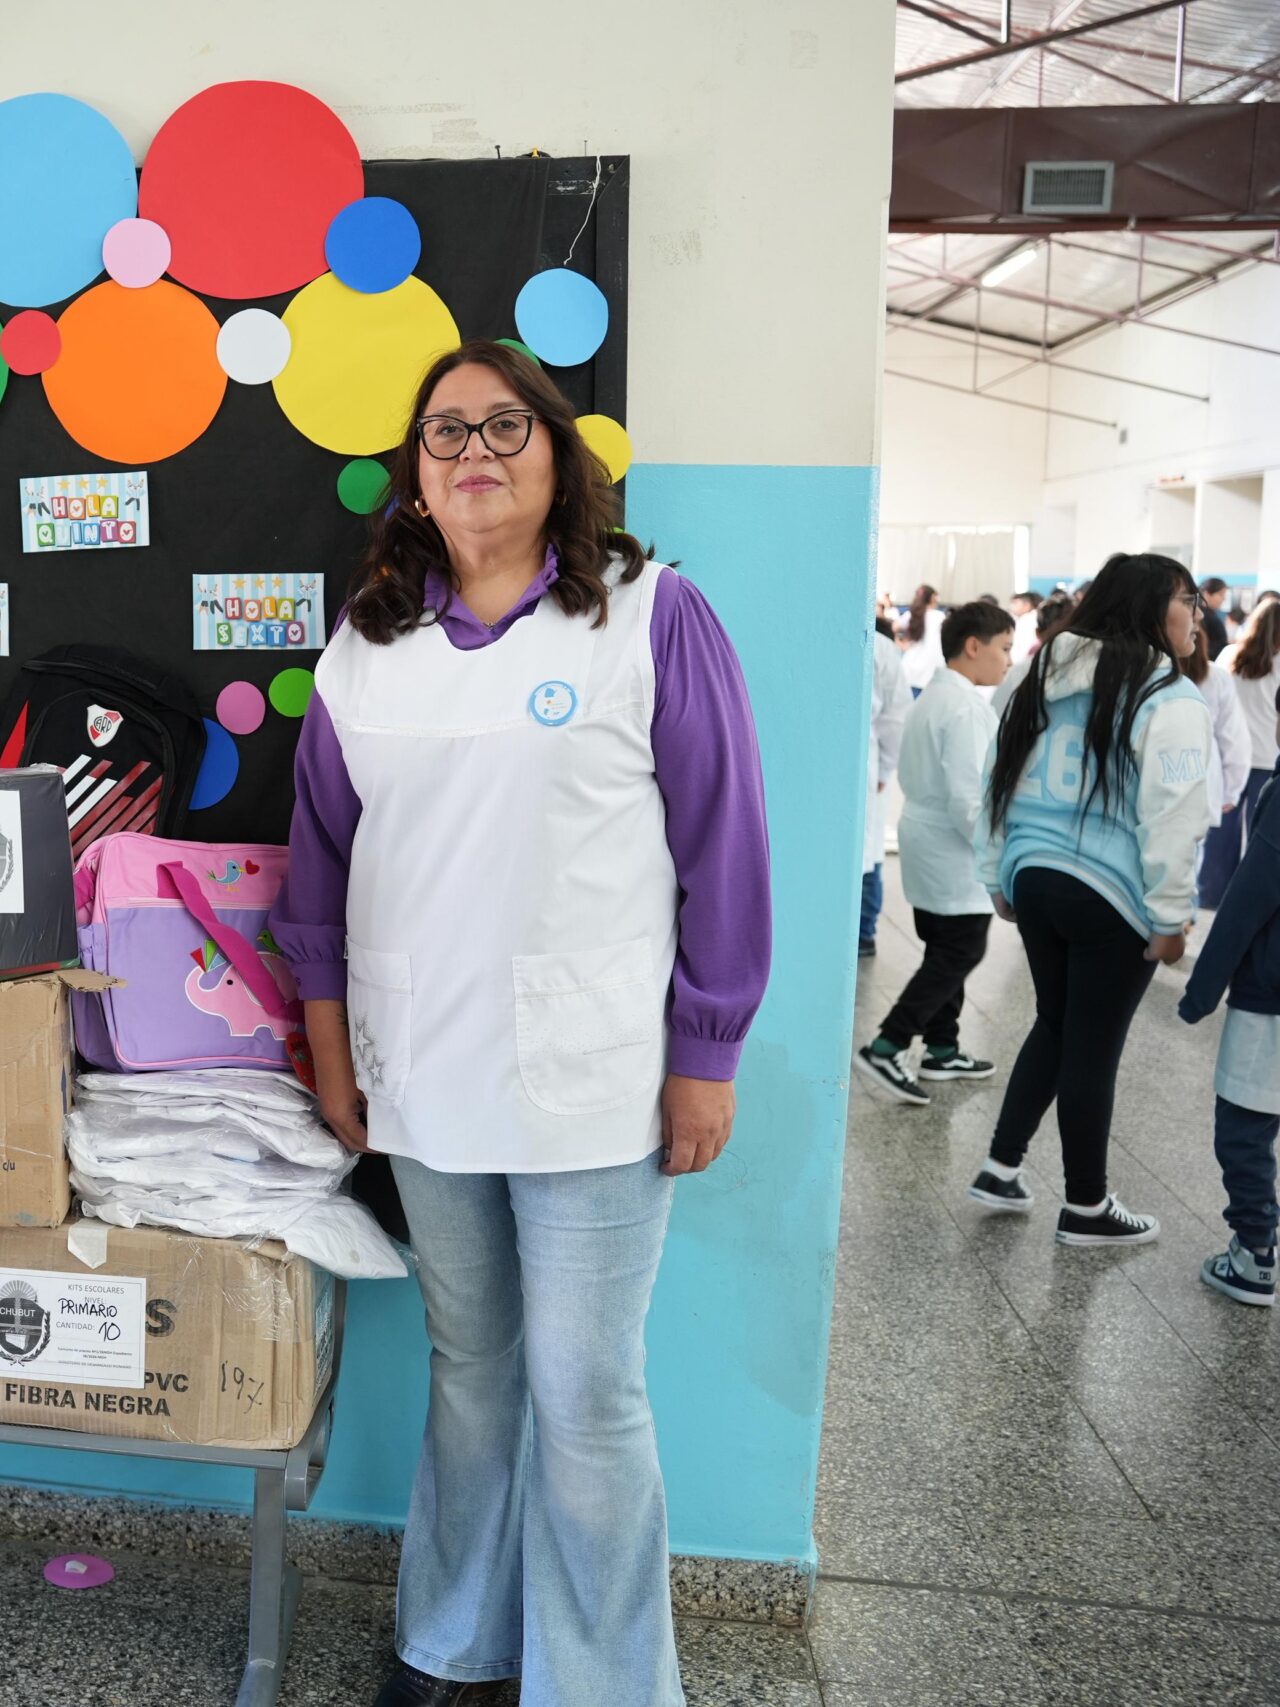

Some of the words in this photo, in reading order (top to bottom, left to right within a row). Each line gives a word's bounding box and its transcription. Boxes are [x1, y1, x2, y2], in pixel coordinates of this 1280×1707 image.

[52, 495, 117, 519] HOLA
[37, 521, 136, 546] QUINTO
[225, 598, 295, 620] HOLA
[217, 622, 304, 646] SEXTO
[84, 1285, 124, 1295] ESCOLARES
[0, 1307, 36, 1317] CHUBUT
[58, 1298, 118, 1318] PRIMARIO
[56, 1322, 95, 1331] CANTIDAD:
[98, 1321, 121, 1342] 10
[144, 1372, 189, 1393] PVC
[5, 1383, 77, 1409] FIBRA
[84, 1392, 170, 1416] NEGRA
